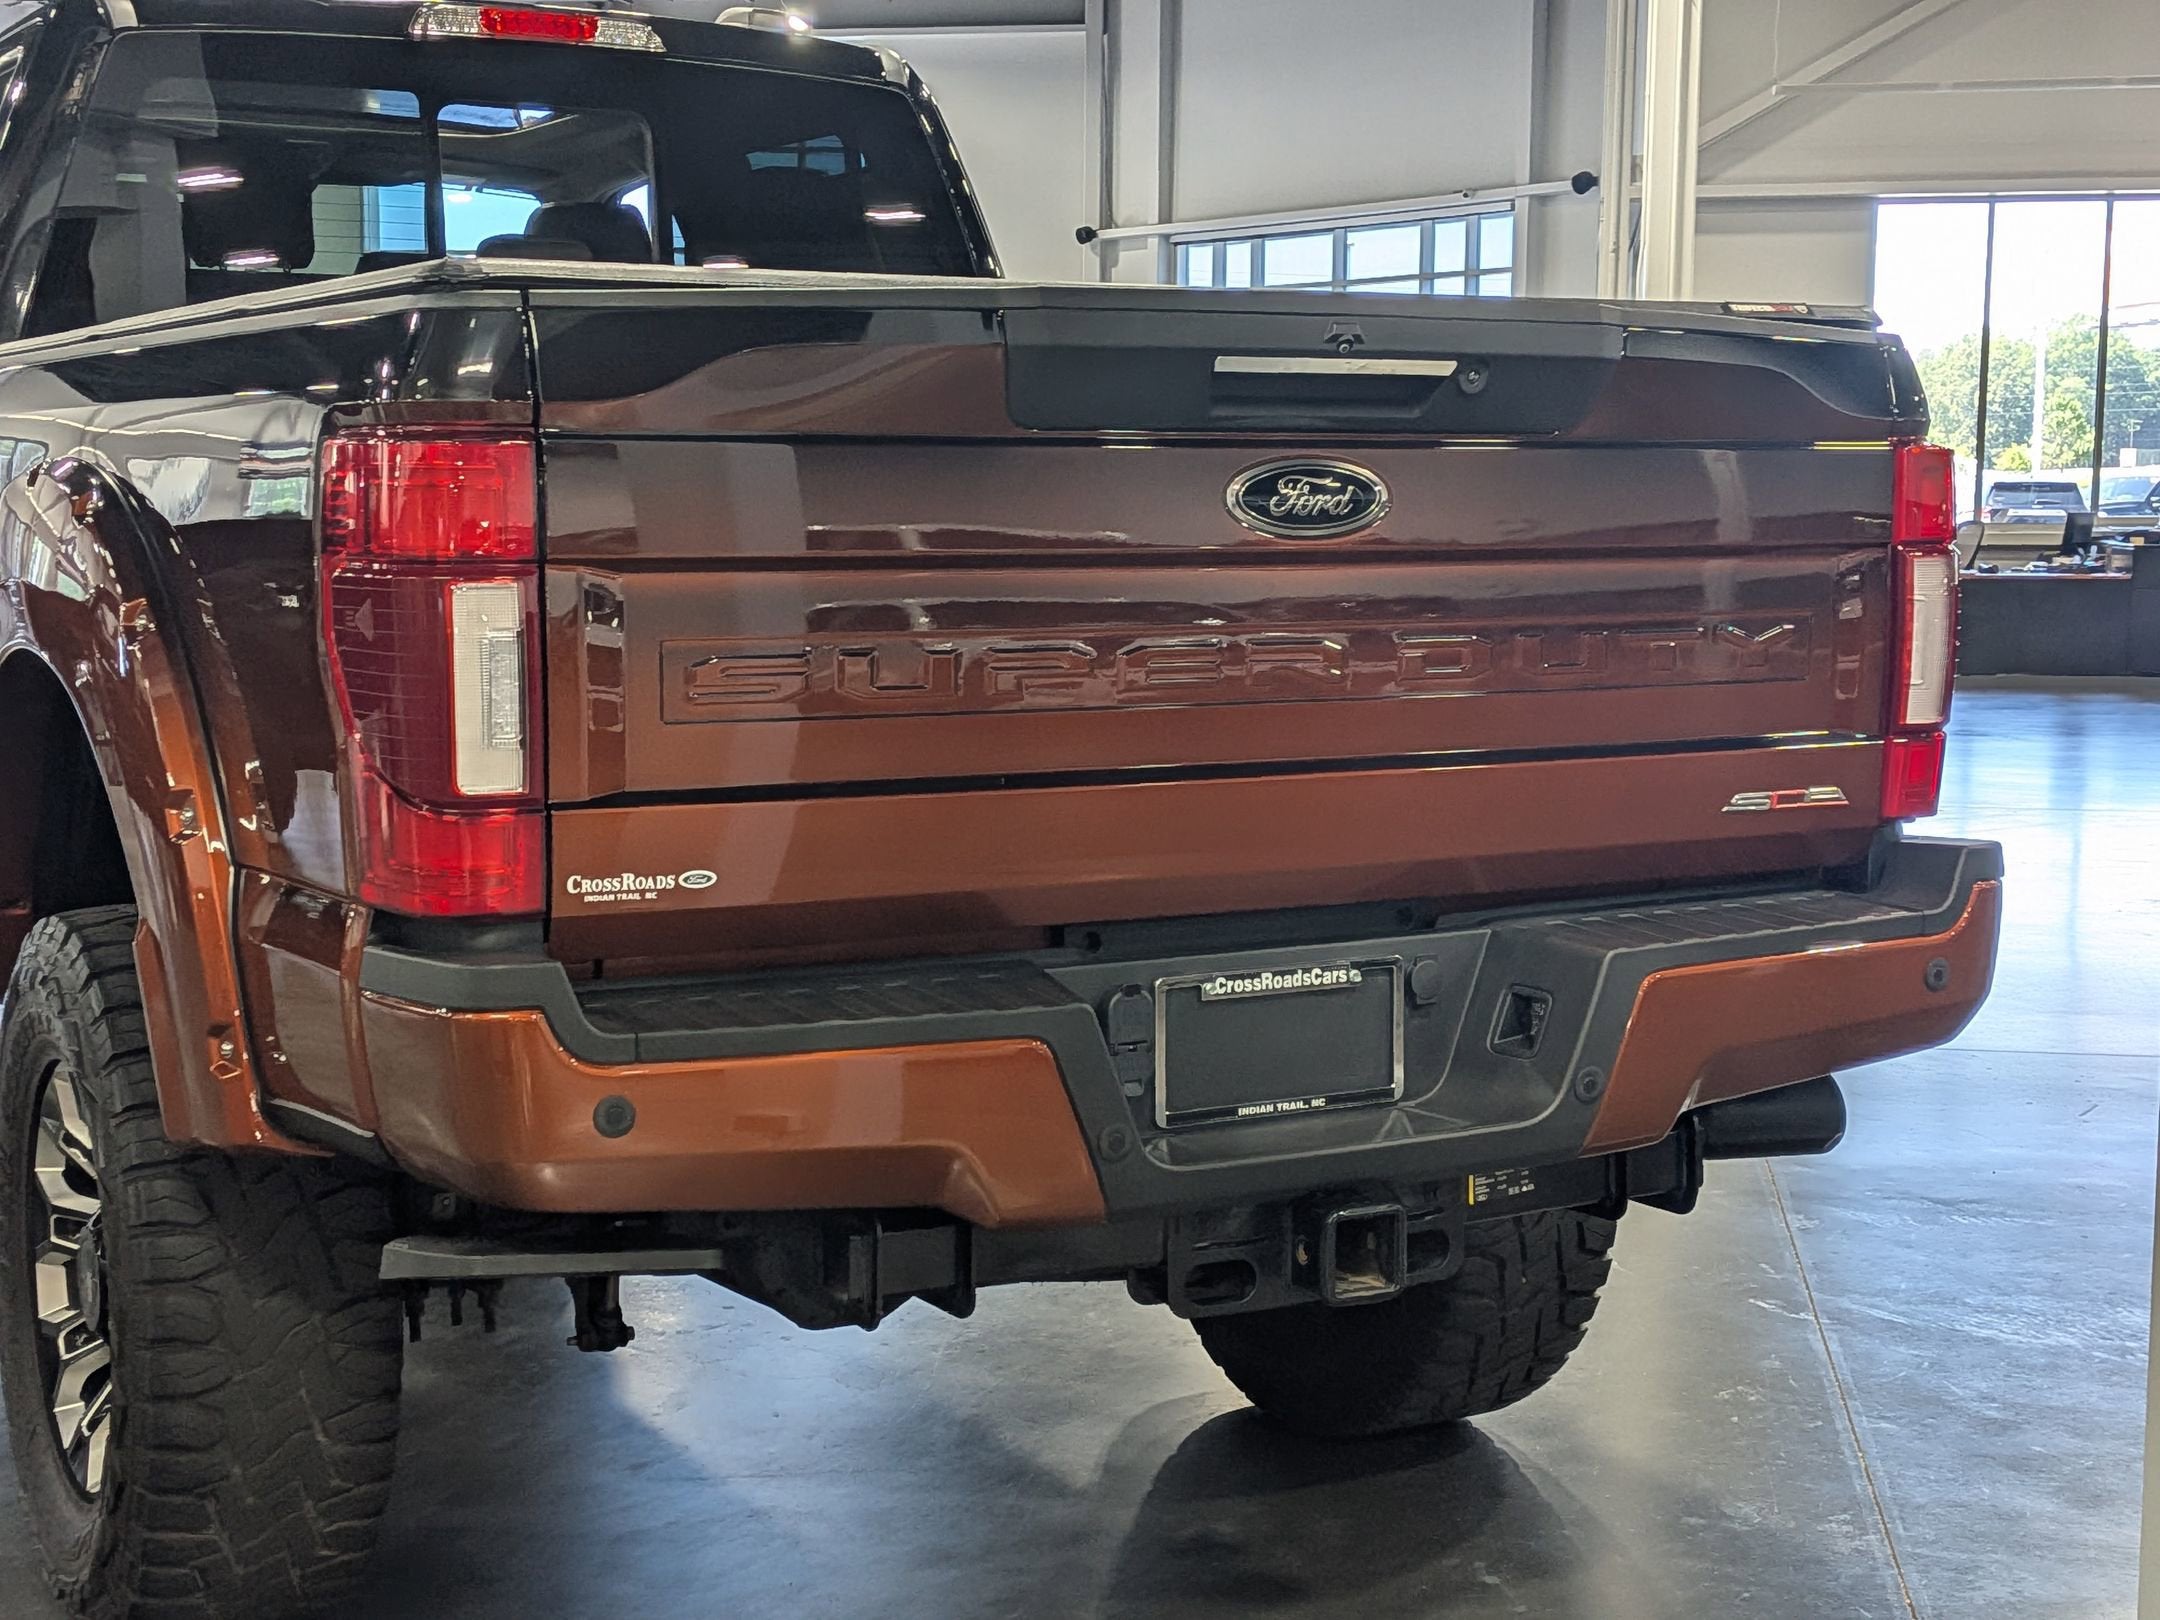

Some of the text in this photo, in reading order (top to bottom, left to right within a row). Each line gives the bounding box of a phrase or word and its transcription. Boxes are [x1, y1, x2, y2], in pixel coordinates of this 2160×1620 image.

[1269, 474, 1355, 517] Ford
[682, 621, 1798, 706] SUPER DUTY
[583, 893, 616, 903] INDIAN
[644, 891, 658, 900] NC
[1215, 967, 1348, 995] CrossRoadsCars
[1238, 1103, 1274, 1116] INDIAN
[1311, 1098, 1326, 1107] NC
